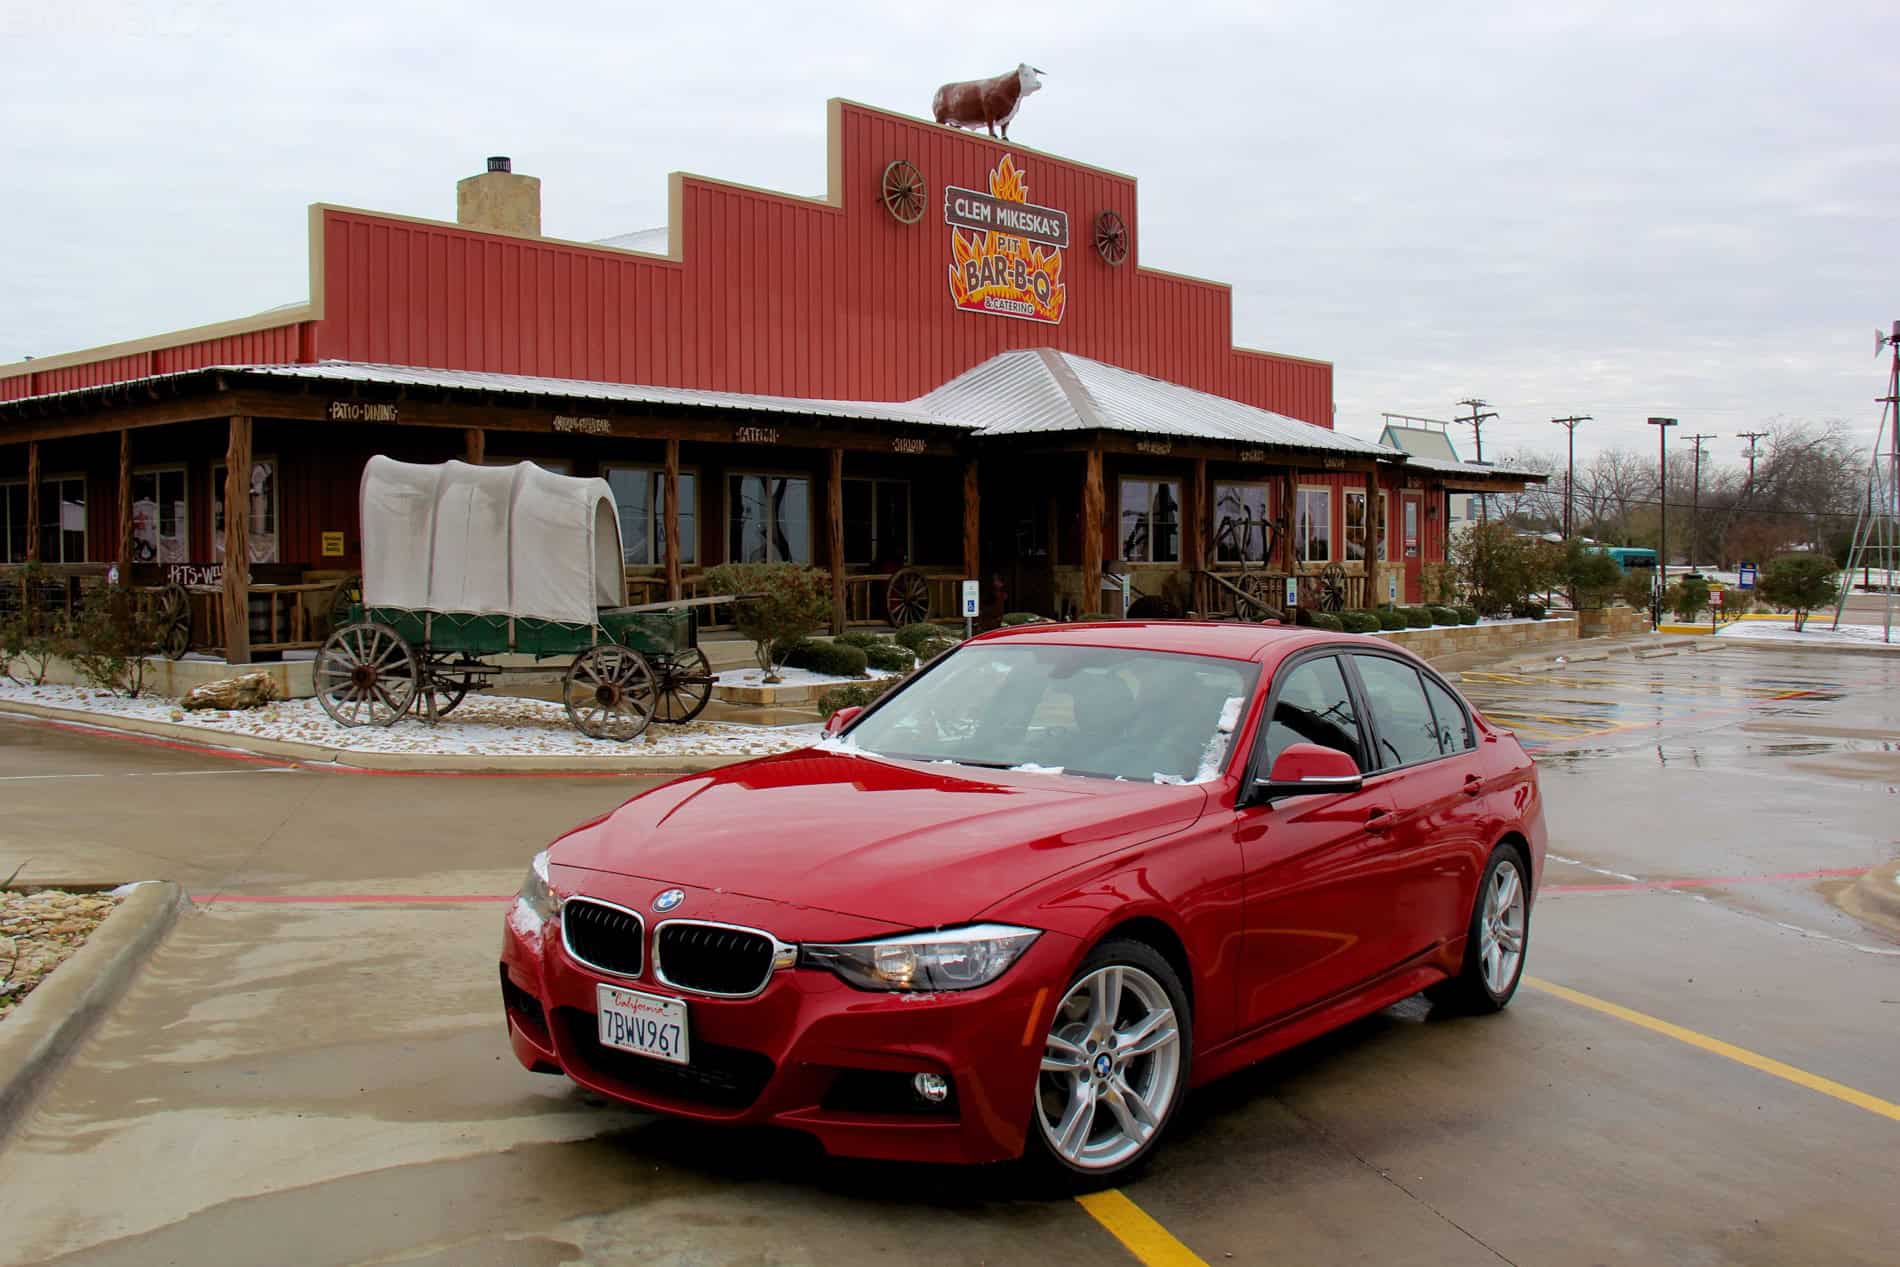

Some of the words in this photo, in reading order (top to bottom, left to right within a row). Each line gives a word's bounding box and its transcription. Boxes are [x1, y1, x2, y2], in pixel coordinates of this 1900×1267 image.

[955, 198, 991, 223] CLEM
[996, 207, 1060, 237] MIKESKA'S
[997, 236, 1020, 252] PIT
[964, 255, 1051, 308] BAR-B-Q
[332, 401, 360, 420] PATIO
[615, 991, 668, 1017] California
[603, 1008, 680, 1054] 7BWV967
